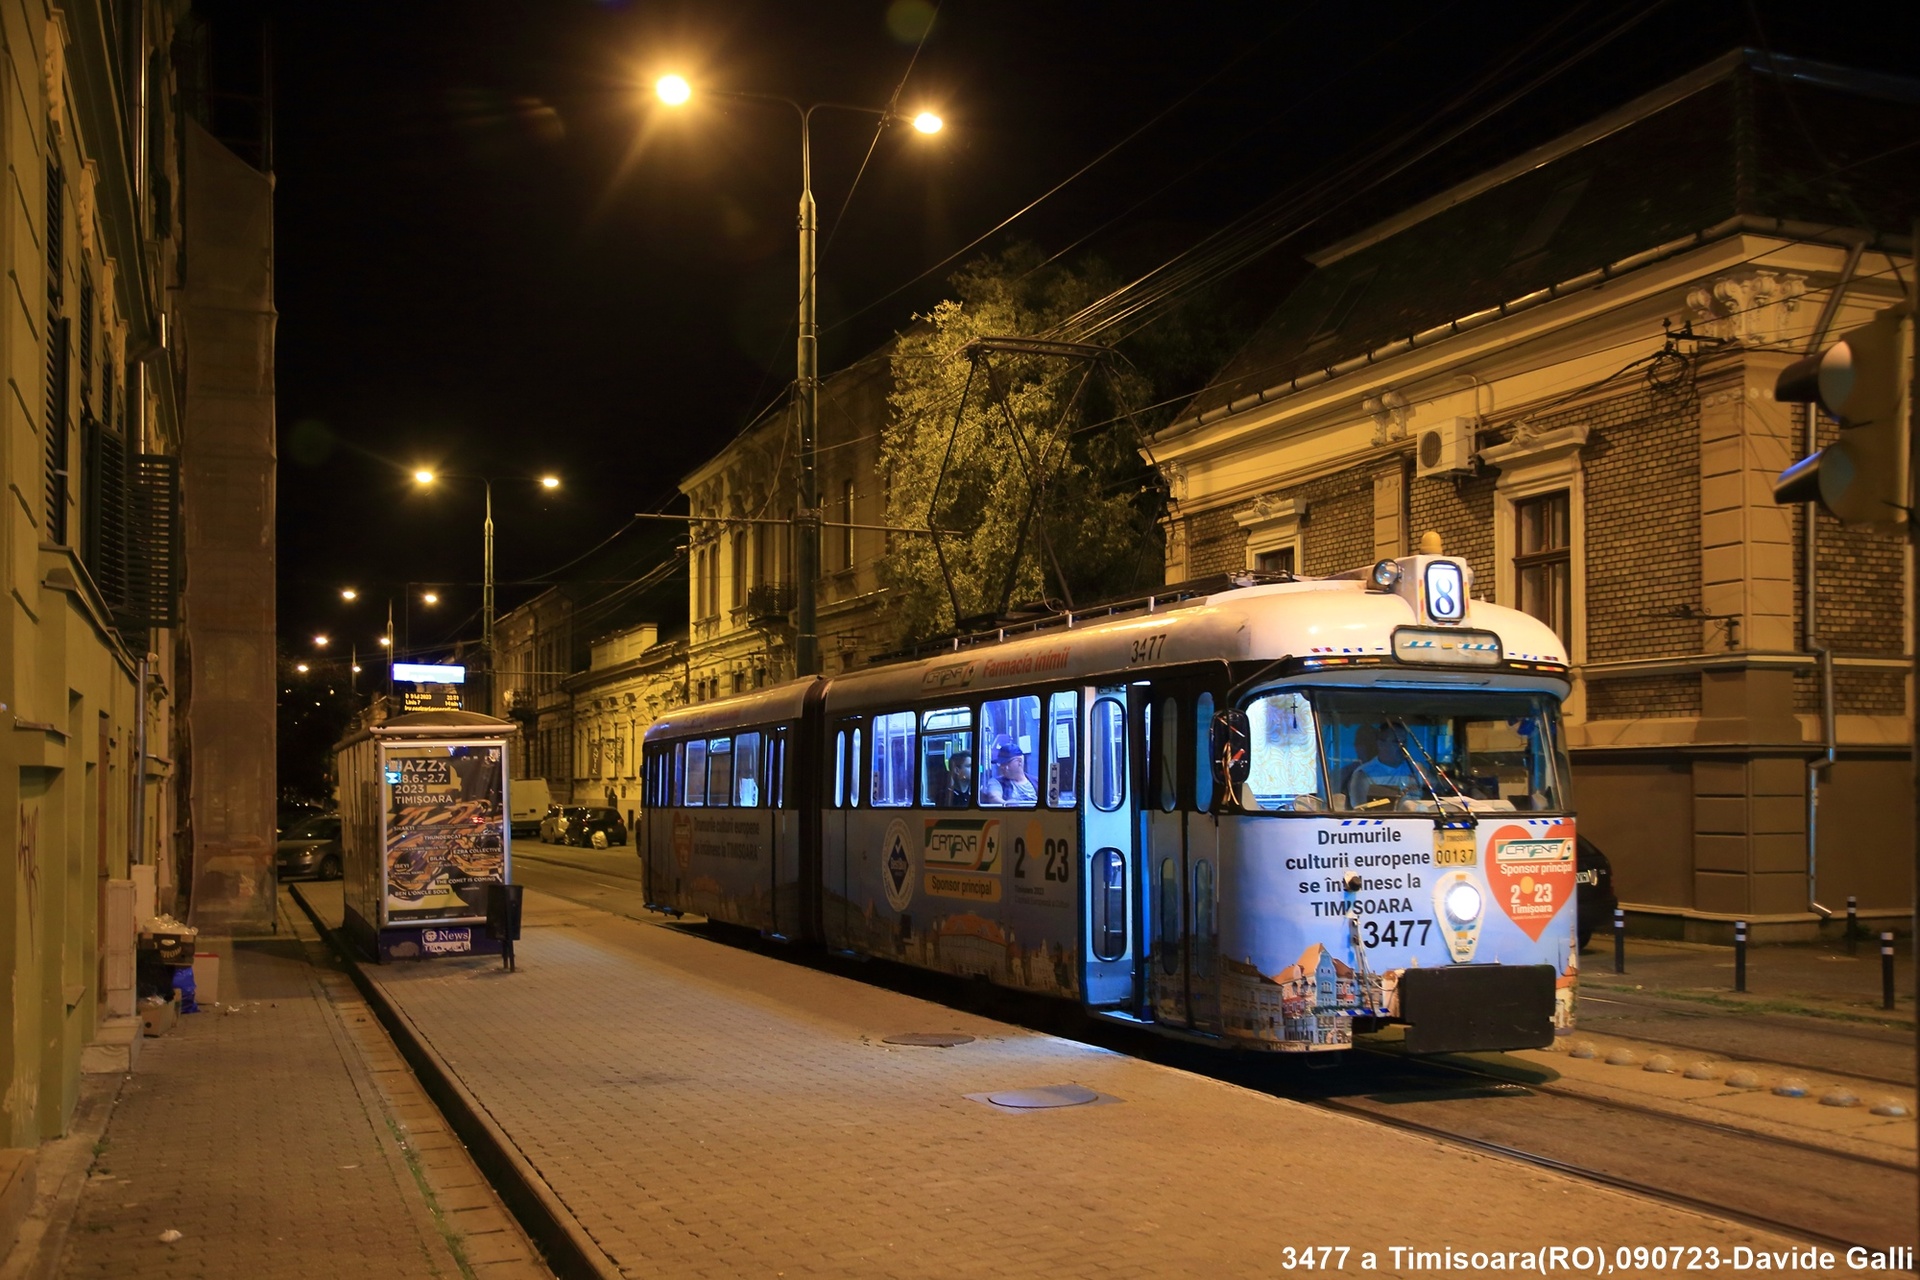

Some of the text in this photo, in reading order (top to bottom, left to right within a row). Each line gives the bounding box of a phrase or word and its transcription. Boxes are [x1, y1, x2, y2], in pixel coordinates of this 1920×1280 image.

[1435, 577, 1455, 616] 8
[1131, 634, 1167, 663] 3477
[395, 784, 425, 795] 2023
[1318, 828, 1401, 845] Drumurile
[931, 834, 977, 859] CATENA
[1505, 844, 1559, 858] CATENA
[1285, 853, 1430, 870] culturii europene
[1436, 849, 1474, 864] 00137
[1500, 861, 1572, 877] Sponsor principal
[931, 875, 992, 898] Sponsor principal
[1299, 881, 1320, 893] se
[1407, 873, 1421, 888] la
[439, 930, 469, 941] News
[1363, 919, 1432, 949] 3477
